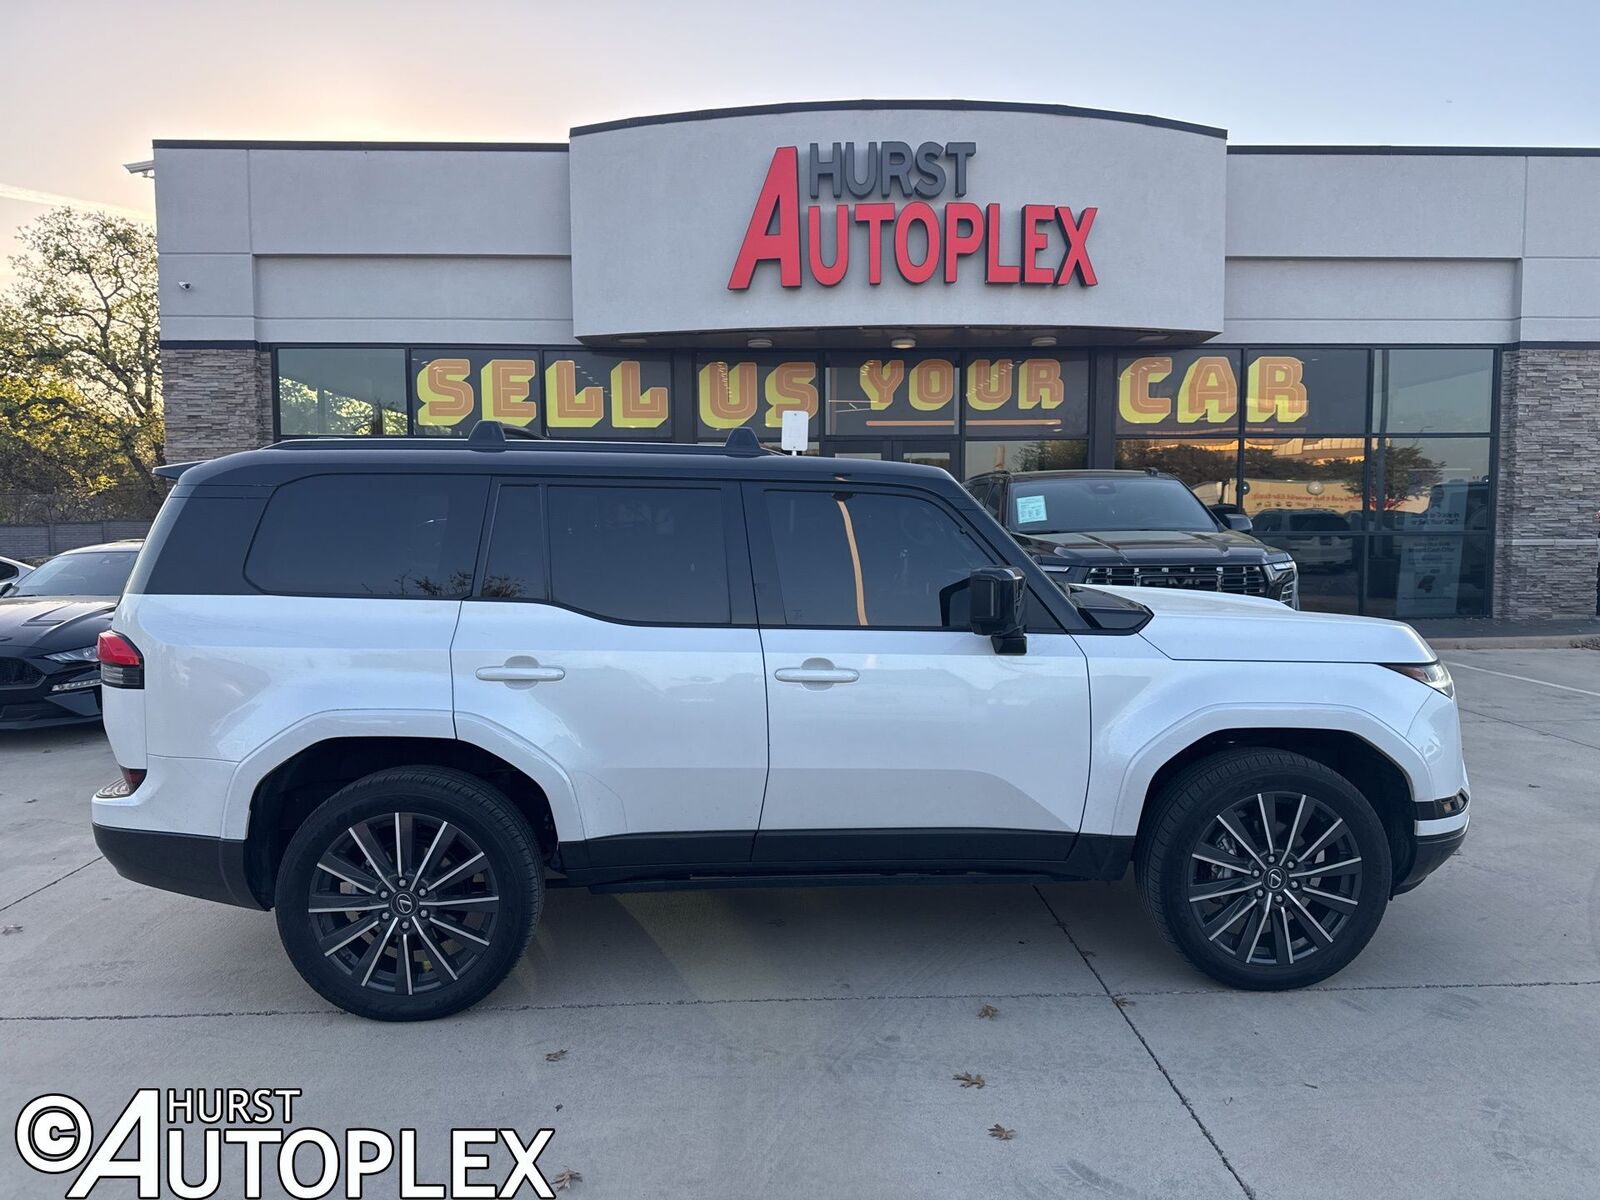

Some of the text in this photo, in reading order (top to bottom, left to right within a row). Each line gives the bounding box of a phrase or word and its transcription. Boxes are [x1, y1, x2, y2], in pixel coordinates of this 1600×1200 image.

[809, 141, 977, 199] HURST
[727, 145, 1099, 291] AUTOPLEX
[416, 356, 1308, 429] SELL US YOUR CAR
